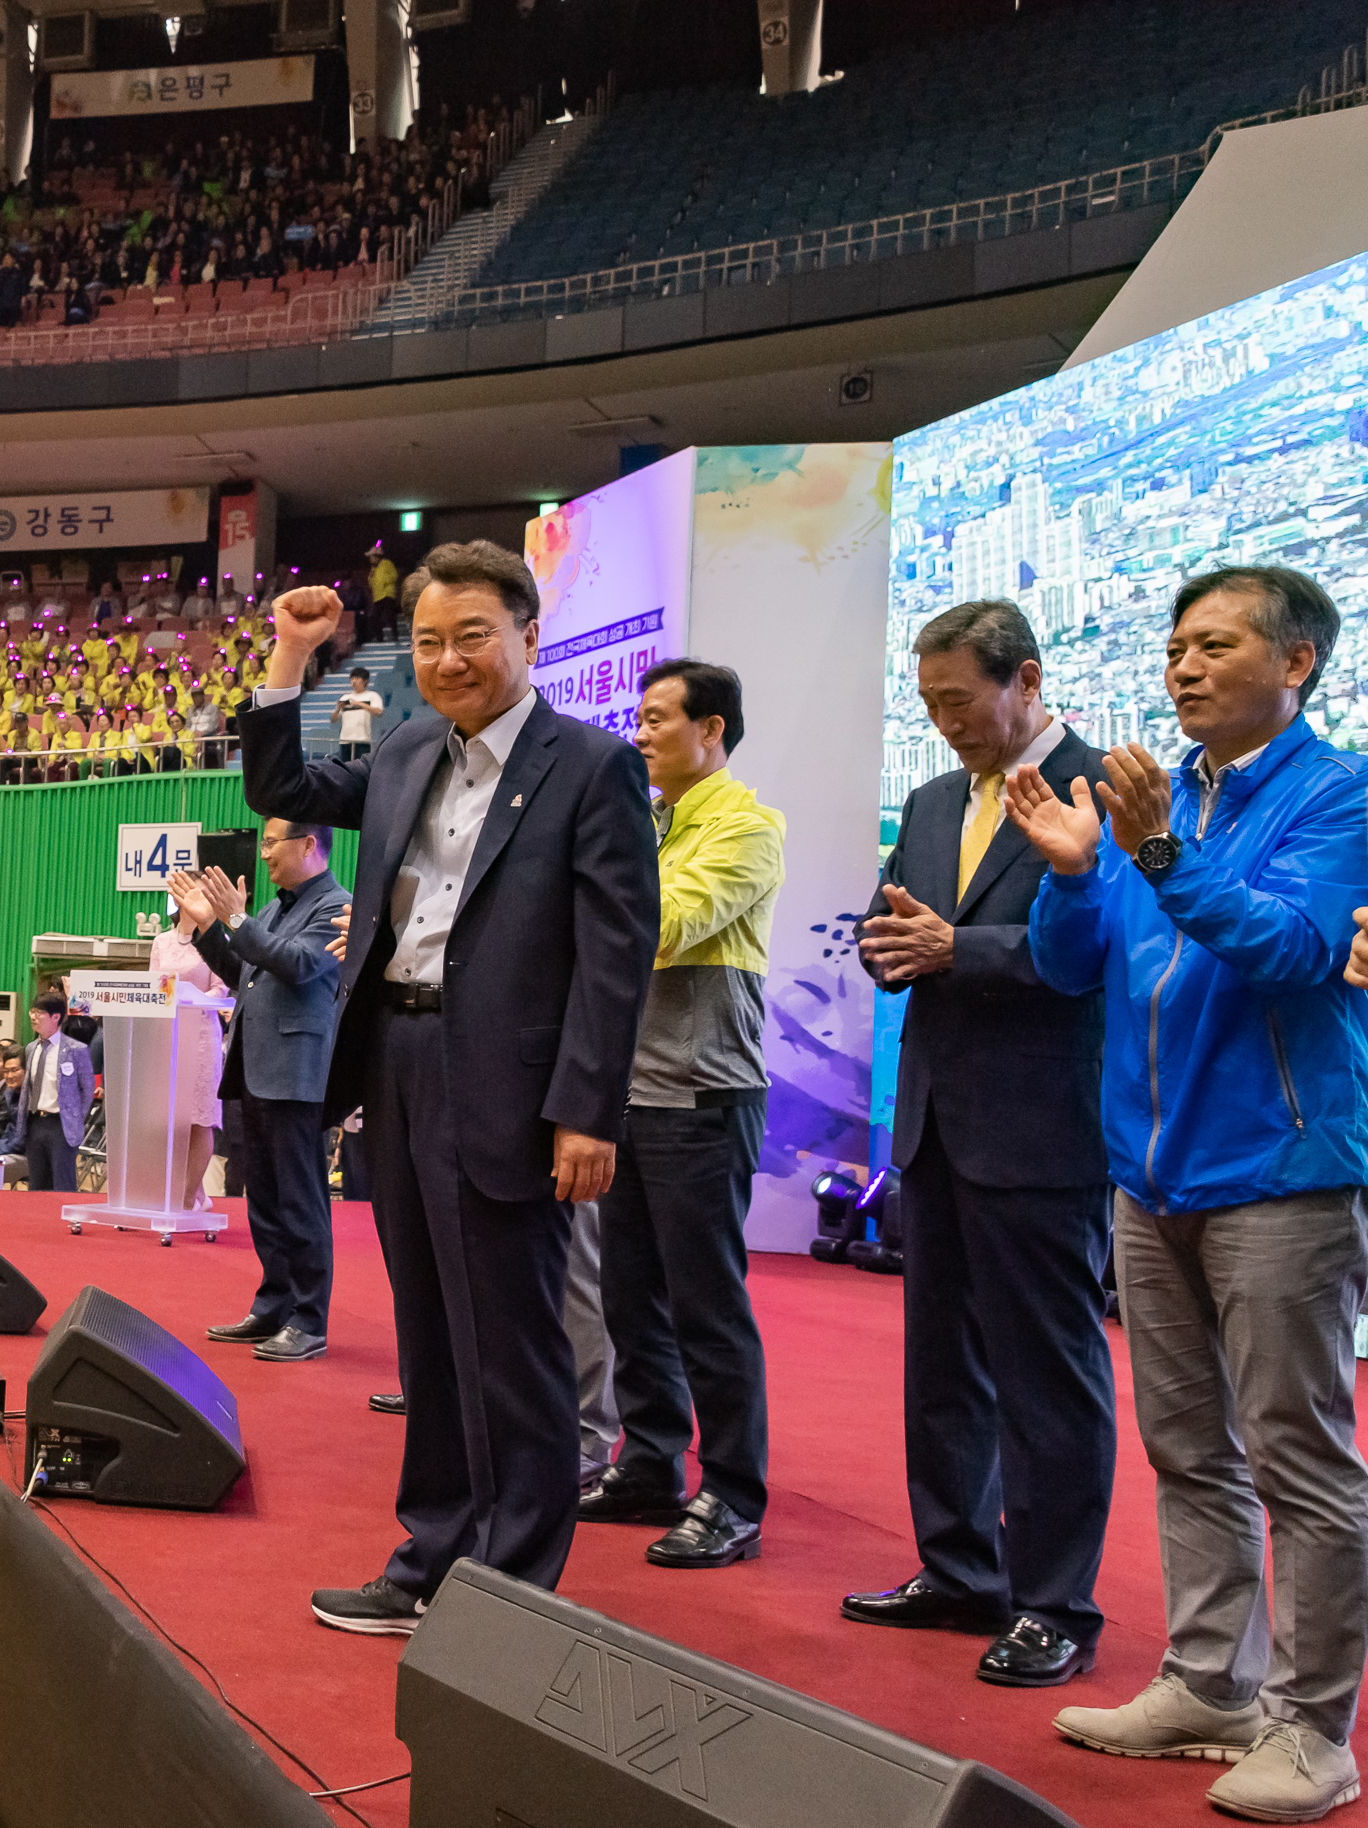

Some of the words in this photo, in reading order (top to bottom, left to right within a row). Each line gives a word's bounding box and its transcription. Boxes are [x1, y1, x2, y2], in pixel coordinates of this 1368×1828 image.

[157, 72, 232, 101] 은평구
[26, 505, 116, 537] 강동구
[575, 646, 656, 706] 서울시민
[78, 991, 94, 999] 2019
